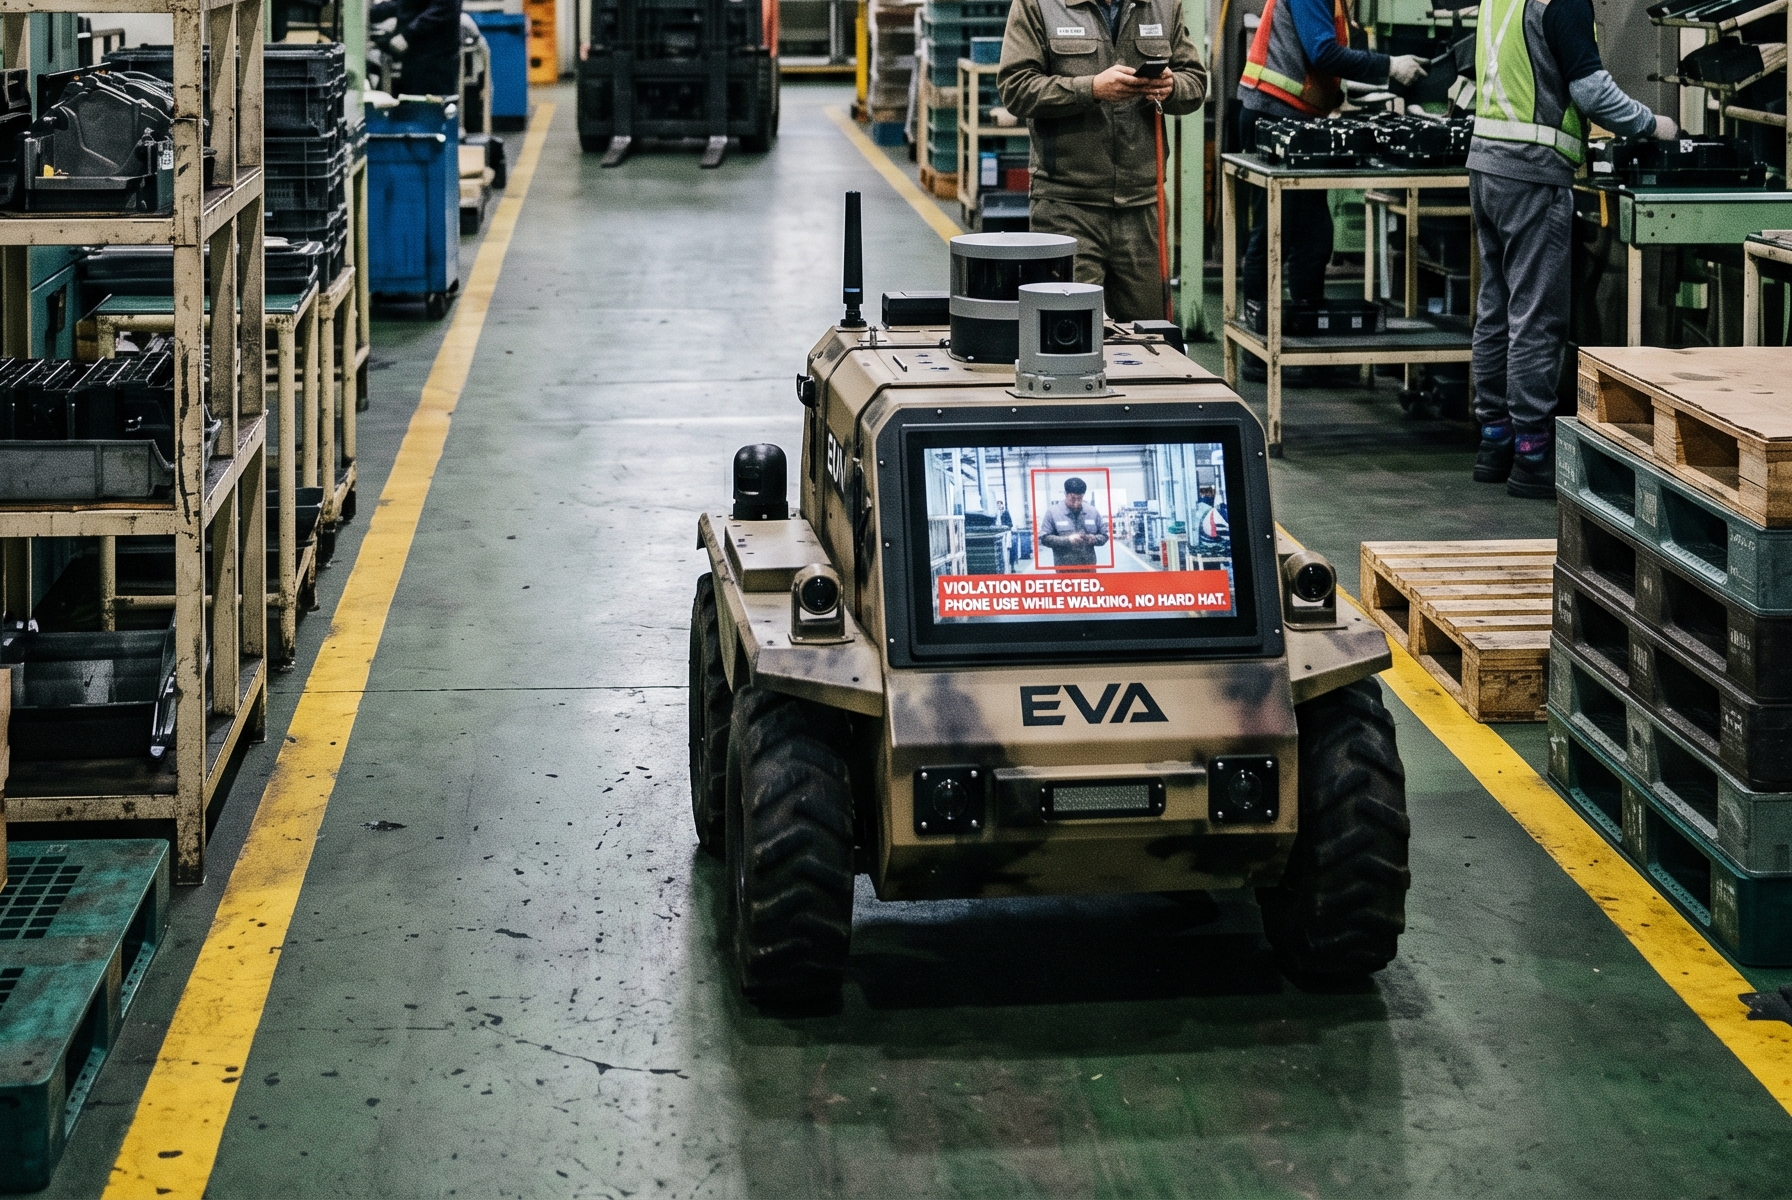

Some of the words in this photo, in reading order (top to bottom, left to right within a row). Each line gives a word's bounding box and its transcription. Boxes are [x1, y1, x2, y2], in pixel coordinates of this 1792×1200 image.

[943, 580, 1021, 595] VIOLATION
[1025, 578, 1105, 593] DETECTED.
[944, 599, 990, 612] PHONE
[993, 598, 1019, 610] USE
[1022, 596, 1065, 609] WHILE
[1135, 594, 1155, 606] NO
[1158, 593, 1195, 606] HARD
[1198, 592, 1227, 605] HAT.
[1020, 682, 1169, 726] EVA
